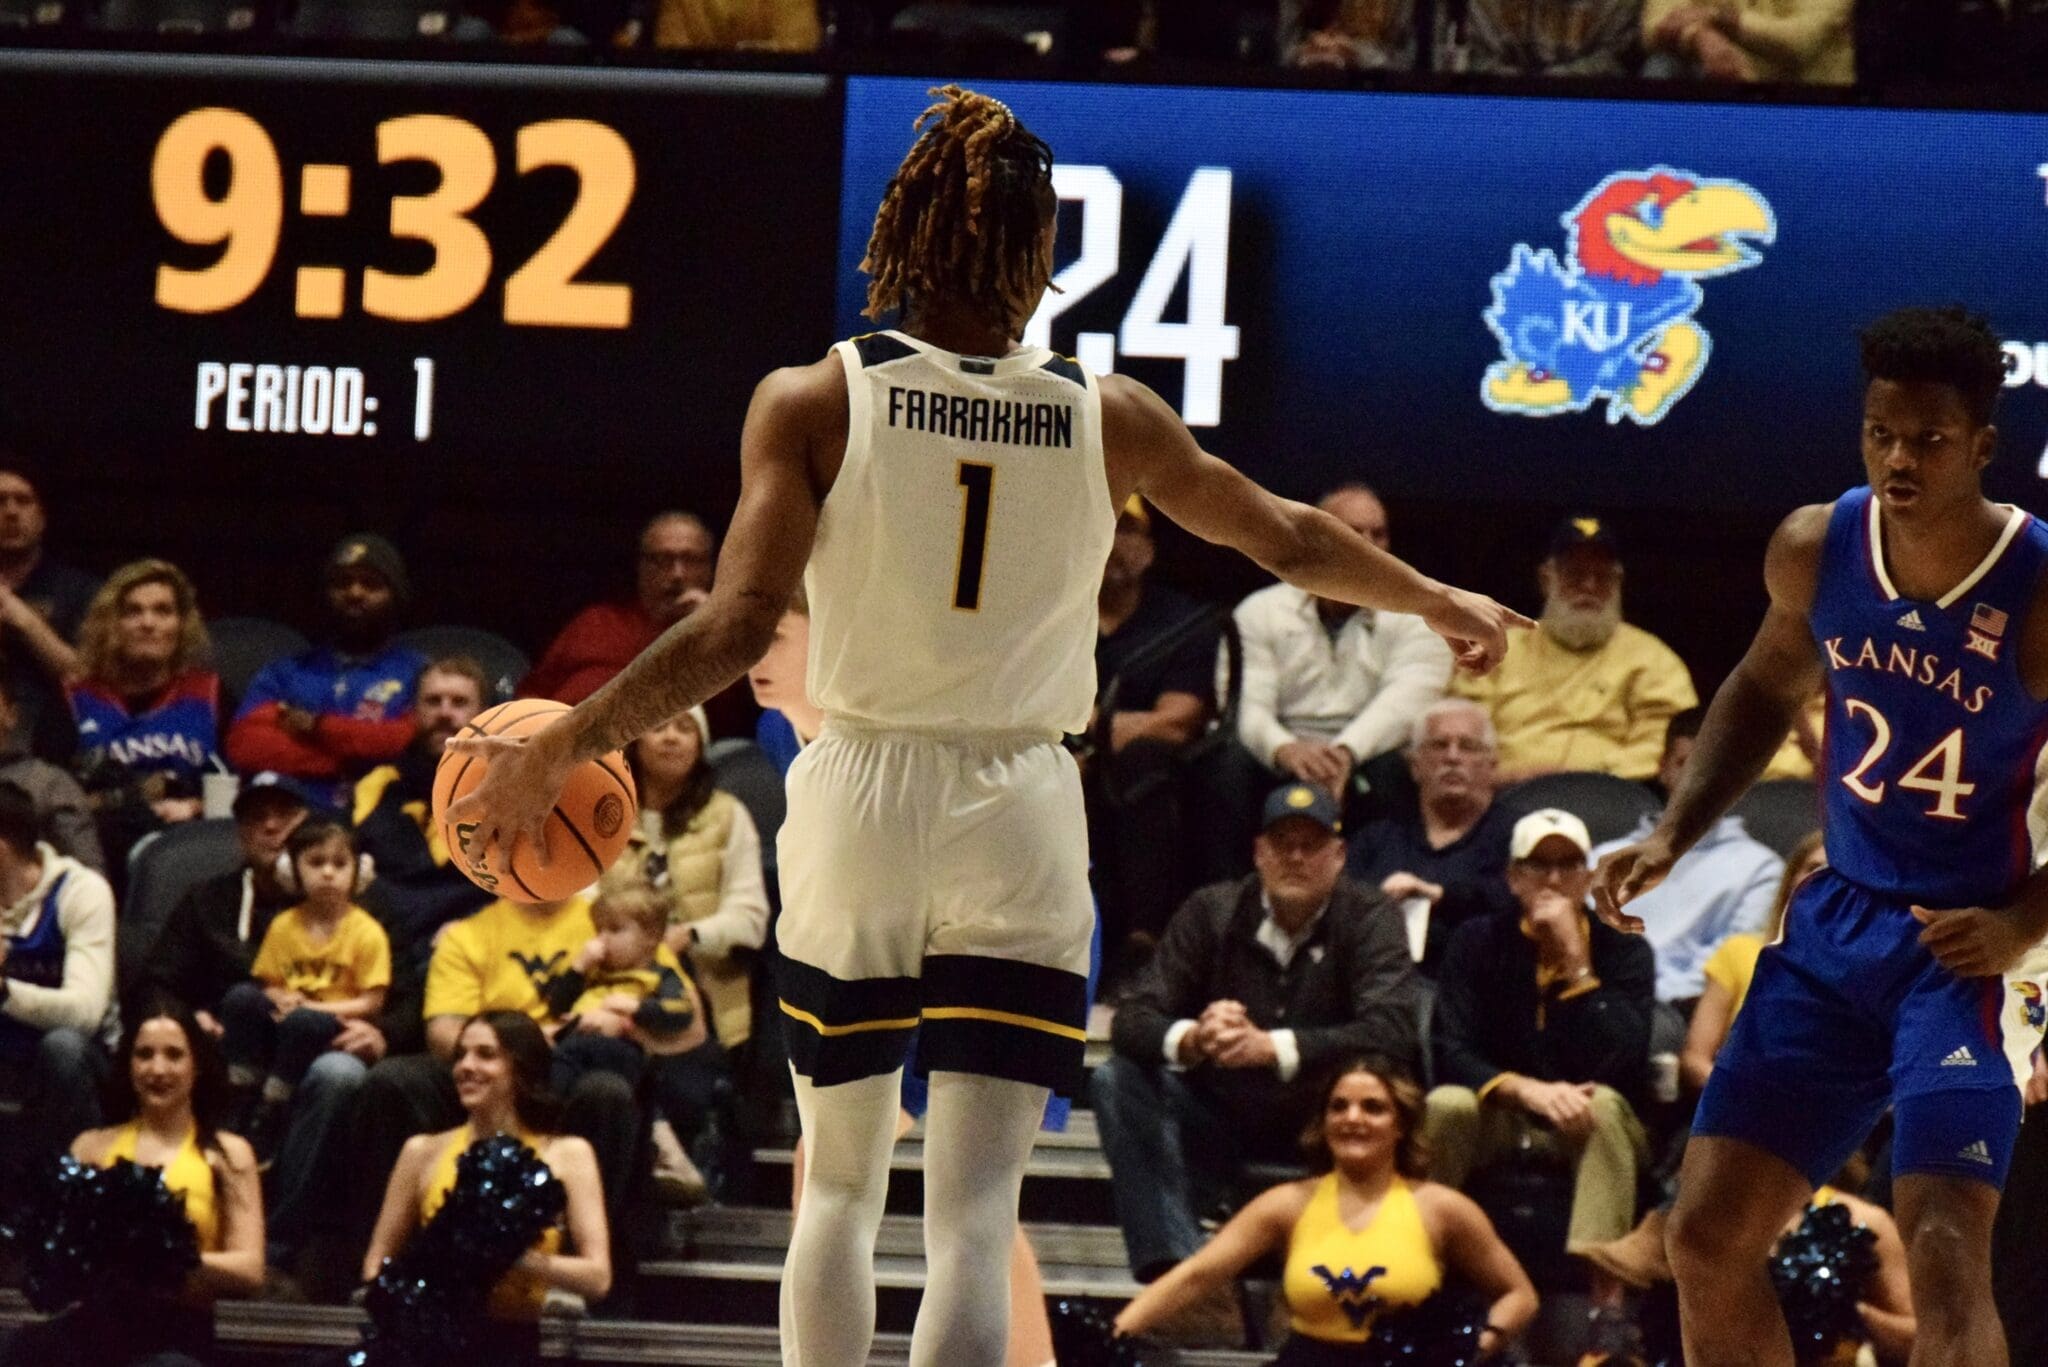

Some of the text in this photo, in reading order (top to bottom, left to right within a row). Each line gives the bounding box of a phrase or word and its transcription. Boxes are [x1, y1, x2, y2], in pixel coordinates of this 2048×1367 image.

[151, 106, 637, 329] 9:32
[1022, 164, 1240, 427] 24
[1562, 299, 1632, 352] KU
[194, 357, 434, 441] PERIOD: 1
[889, 386, 1073, 449] FARRAKHAN
[951, 459, 996, 612] 1
[1824, 637, 1993, 713] KANSAS
[1841, 698, 1976, 820] 24
